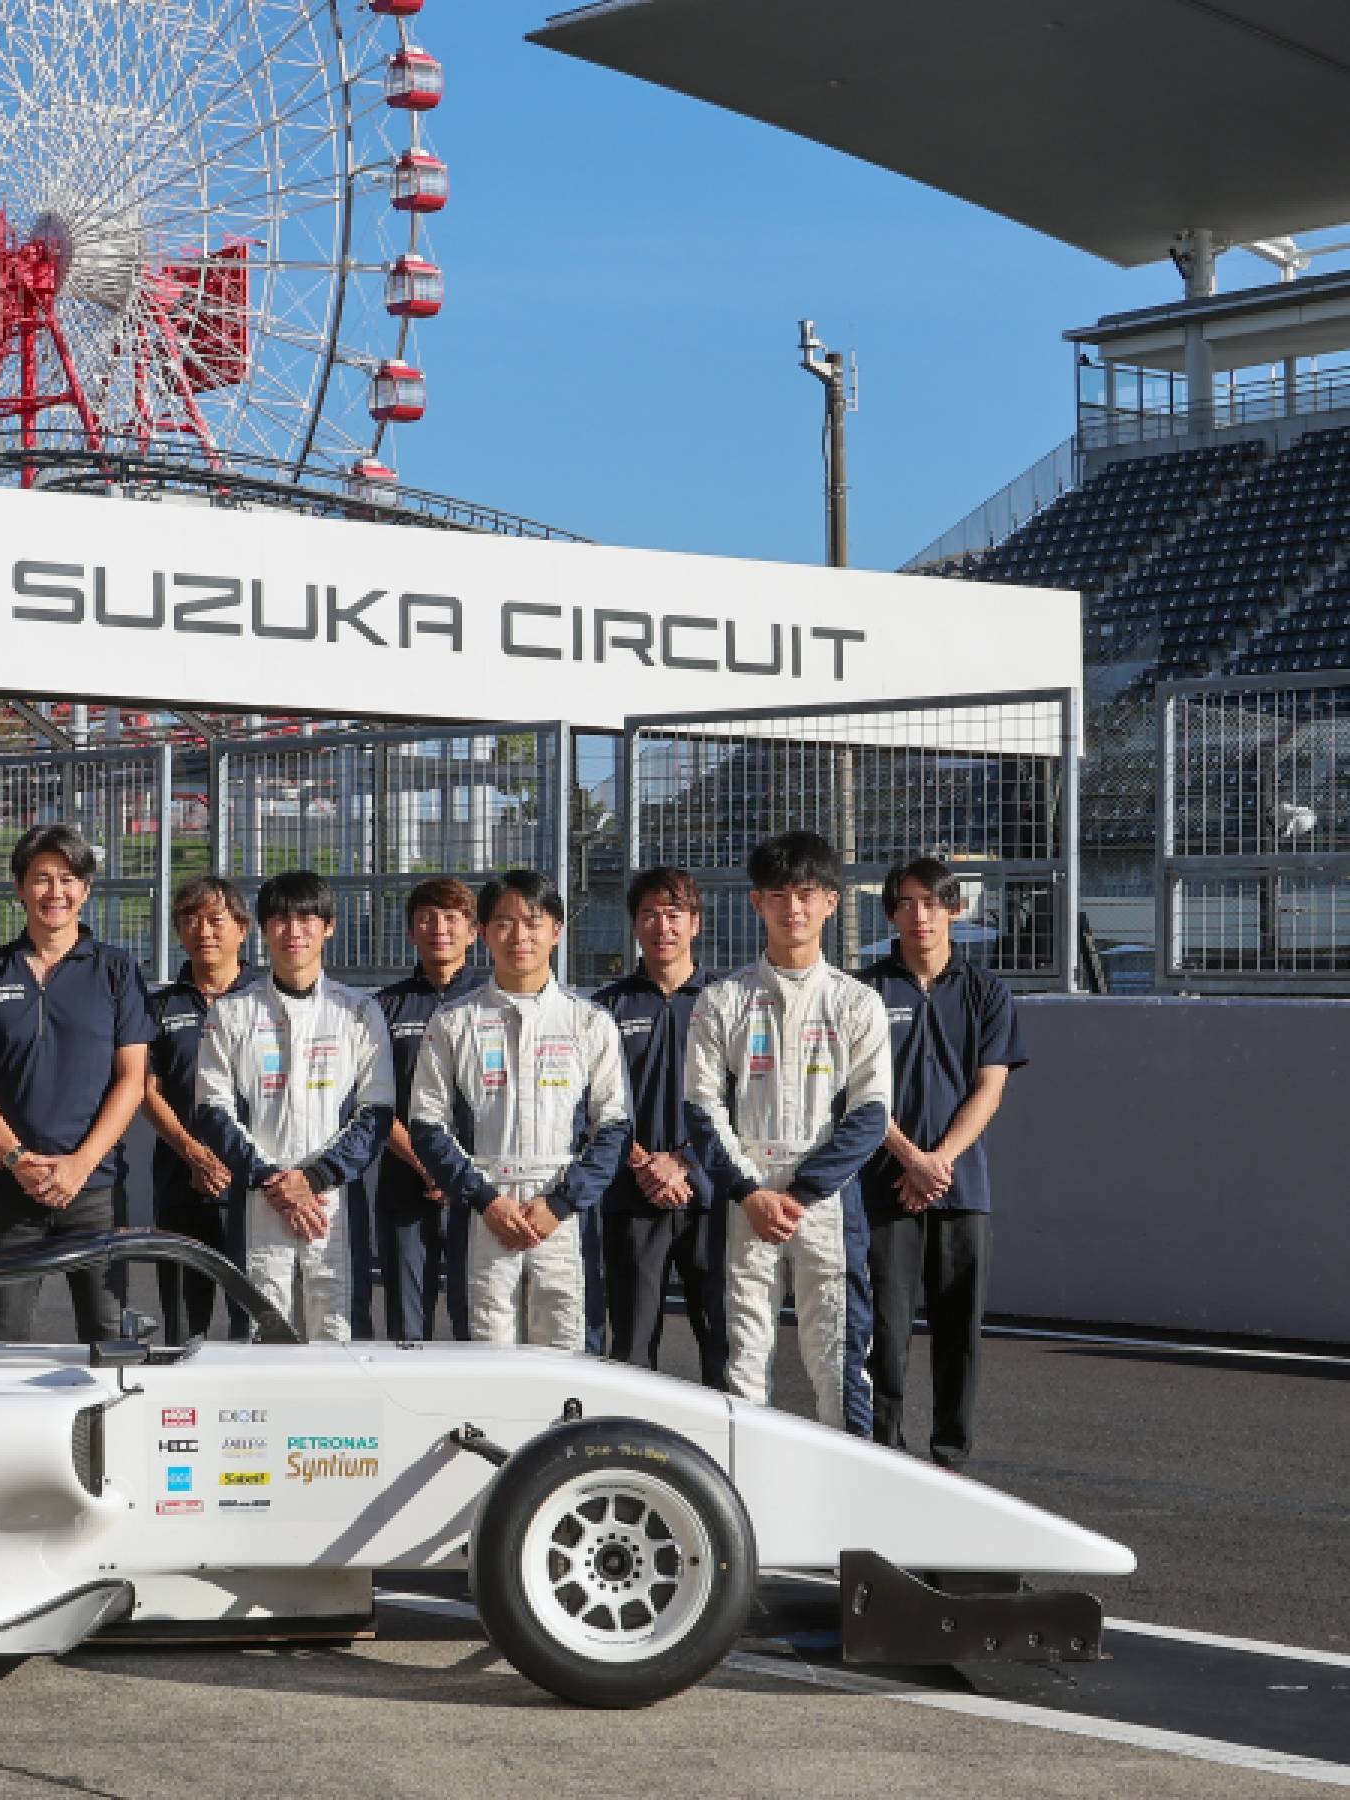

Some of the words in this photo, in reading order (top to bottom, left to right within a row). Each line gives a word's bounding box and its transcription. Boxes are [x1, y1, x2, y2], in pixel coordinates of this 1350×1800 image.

[11, 559, 463, 653] SUZUKA
[500, 600, 867, 682] CIRCUIT
[286, 1436, 379, 1450] PETRONAS
[285, 1452, 379, 1485] Syntium
